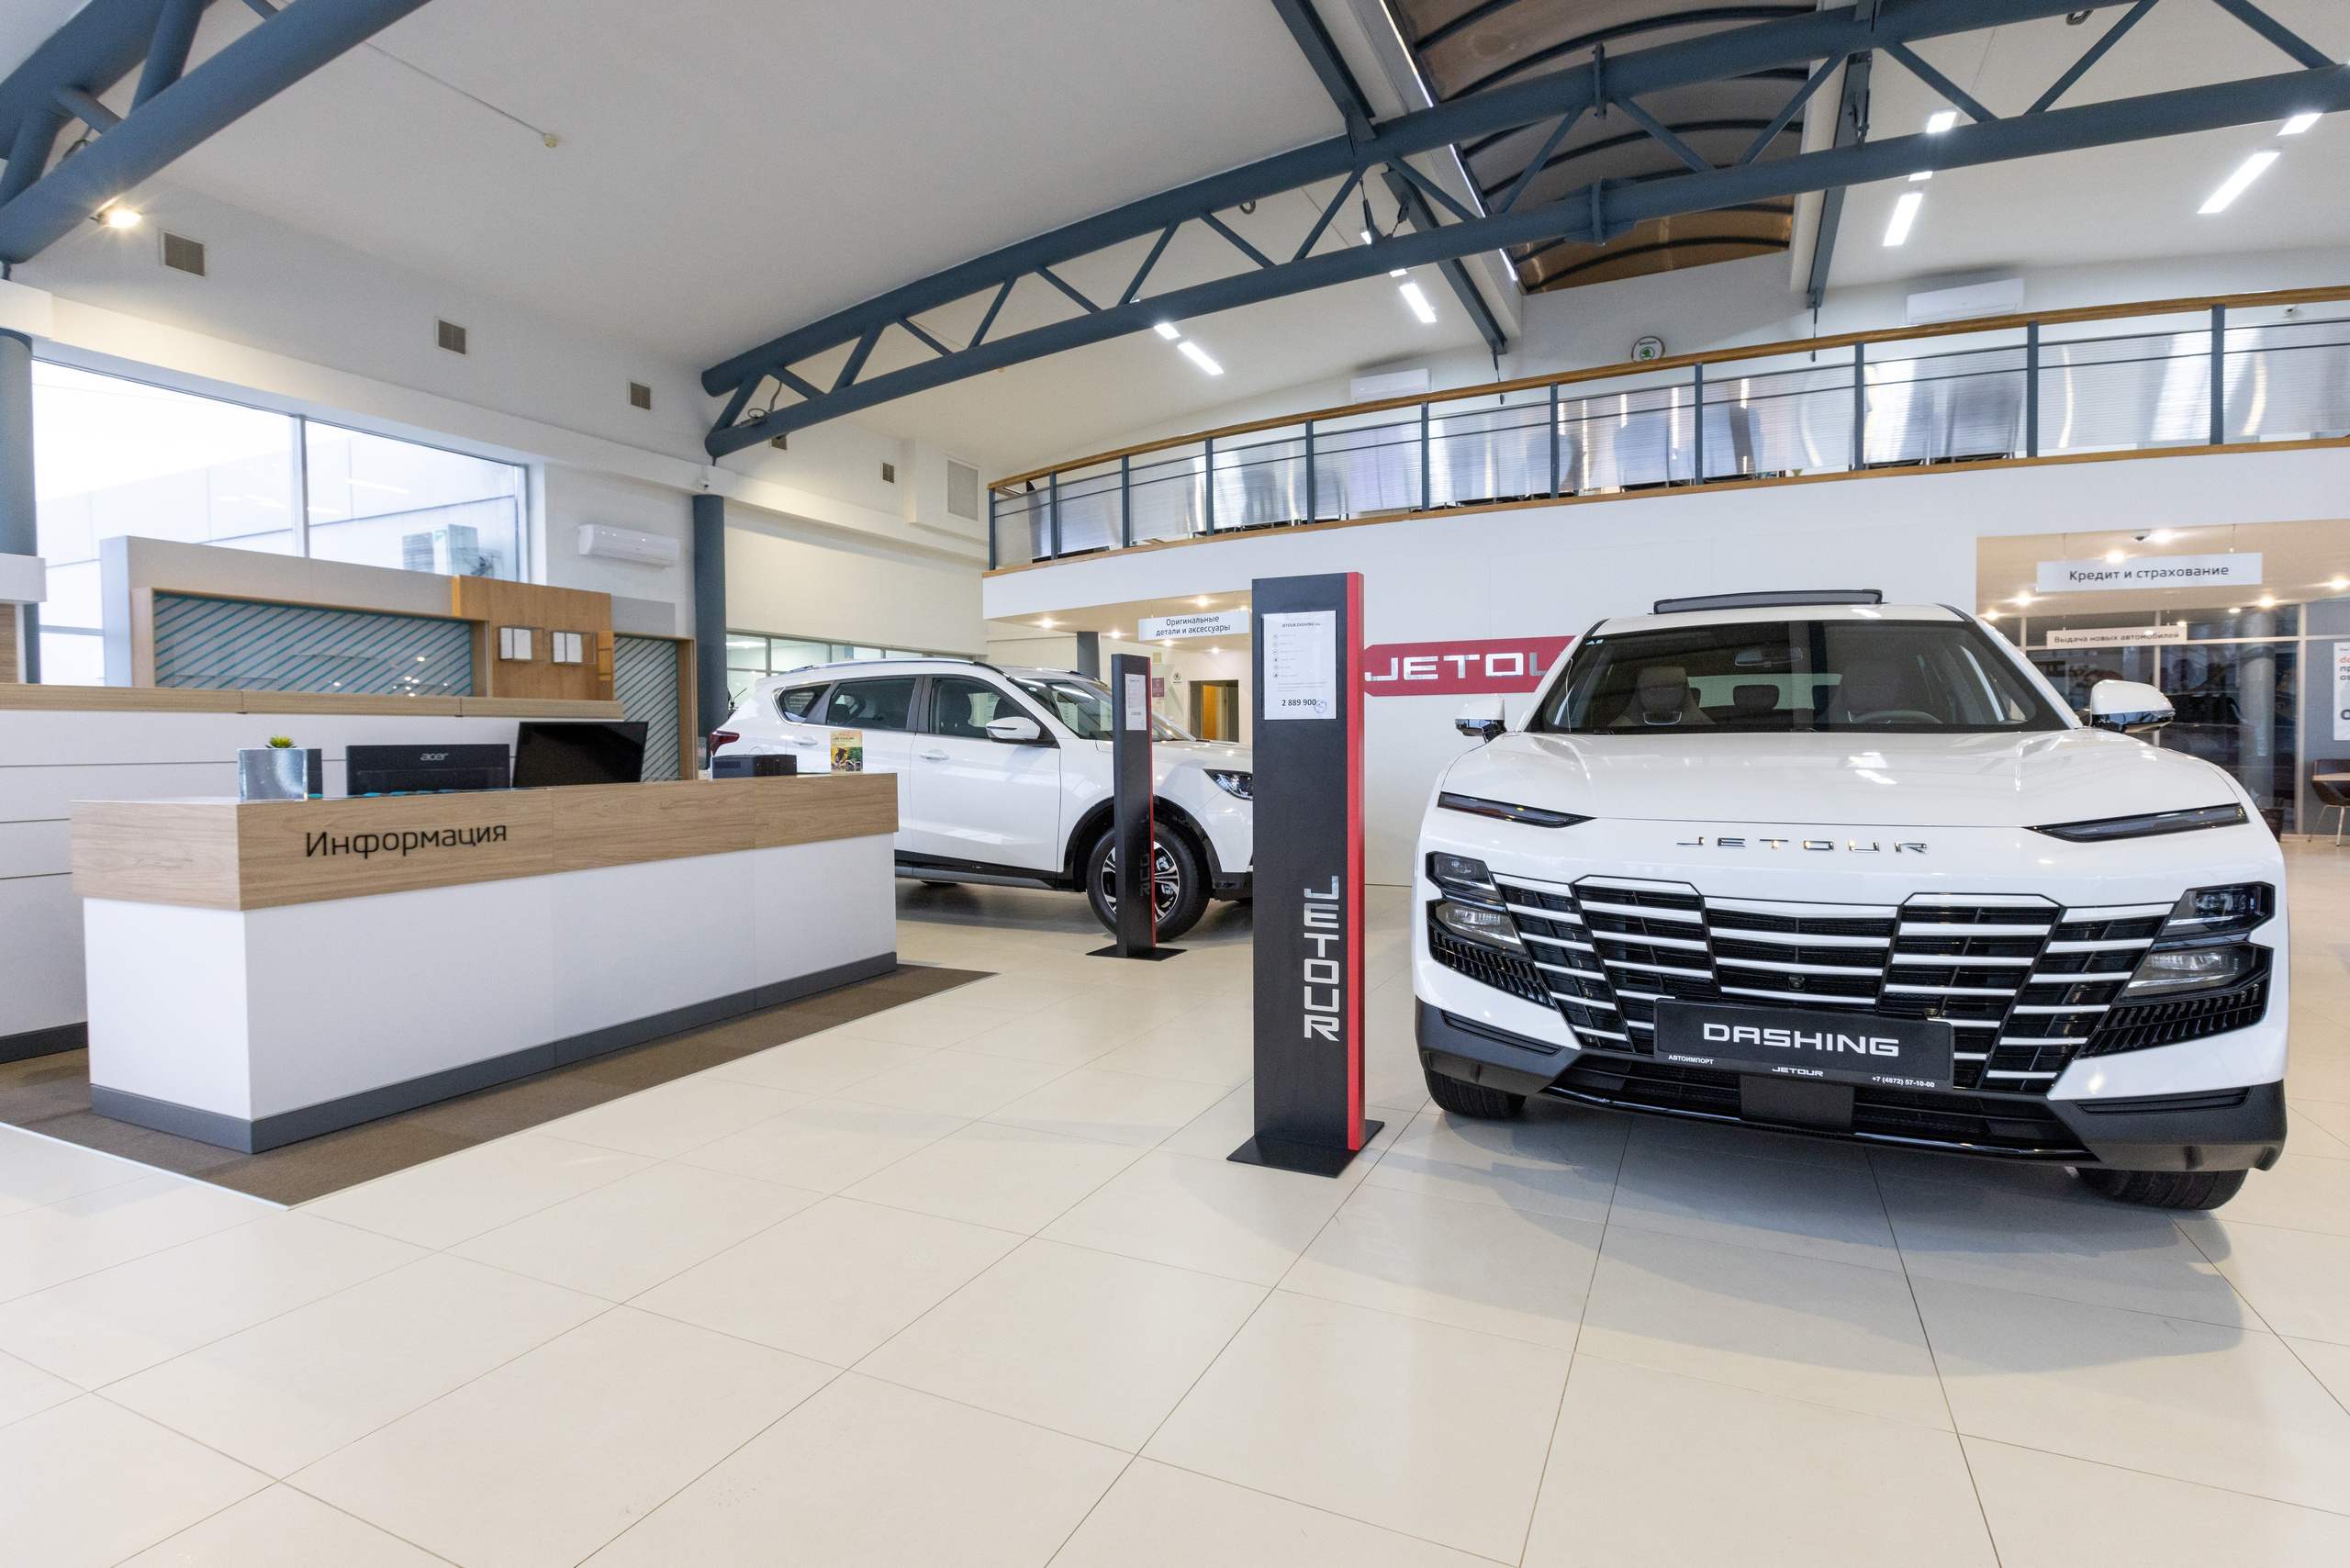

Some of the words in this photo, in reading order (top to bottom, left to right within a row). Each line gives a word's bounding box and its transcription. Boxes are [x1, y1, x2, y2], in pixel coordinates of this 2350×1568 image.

[2069, 570, 2120, 583] Кредит
[2124, 569, 2132, 578] и
[2136, 566, 2230, 579] страхование
[1166, 615, 1220, 627] Оригинальные
[1155, 628, 1181, 637] детали
[1188, 624, 1231, 633] аксессуары
[2054, 635, 2088, 644] Выдача
[2089, 633, 2118, 642] новых
[2120, 631, 2180, 641] автомобилей
[1281, 699, 1286, 707] 2
[420, 753, 449, 761] acer
[306, 823, 508, 860] Информация
[1676, 836, 1928, 854] JETOUR
[1304, 875, 1340, 1042] JETOUR
[1703, 1023, 1899, 1057] DASHING
[1668, 1054, 1714, 1065] АВТОИМПОРТ
[1772, 1067, 1824, 1077] JETOUR
[1882, 1076, 1904, 1086] (4872)
[1905, 1079, 1935, 1088] 57-10-00
